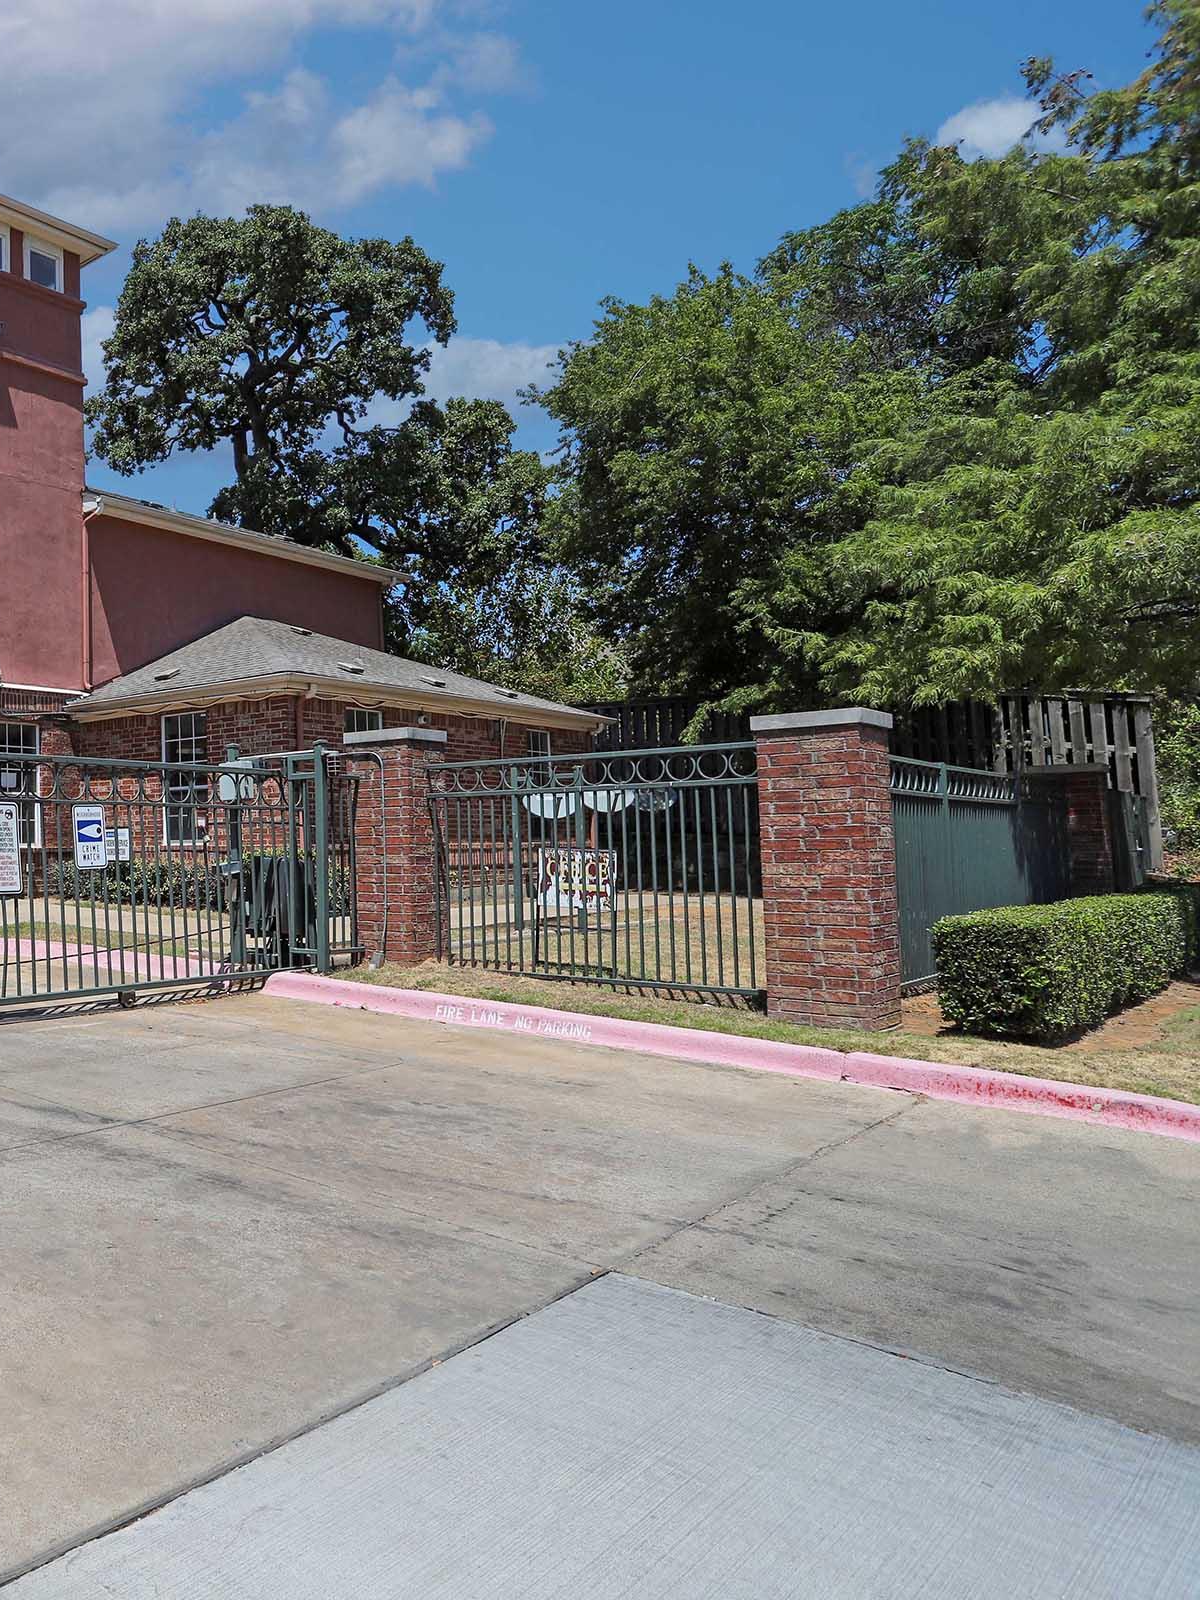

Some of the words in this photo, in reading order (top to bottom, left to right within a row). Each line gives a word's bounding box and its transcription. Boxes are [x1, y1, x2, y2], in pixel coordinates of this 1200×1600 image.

[82, 844, 100, 853] CRIME
[435, 1004, 465, 1020] FIRE
[470, 1008, 506, 1025] LANE
[514, 1016, 533, 1030] NO
[537, 1018, 592, 1038] PARKING
